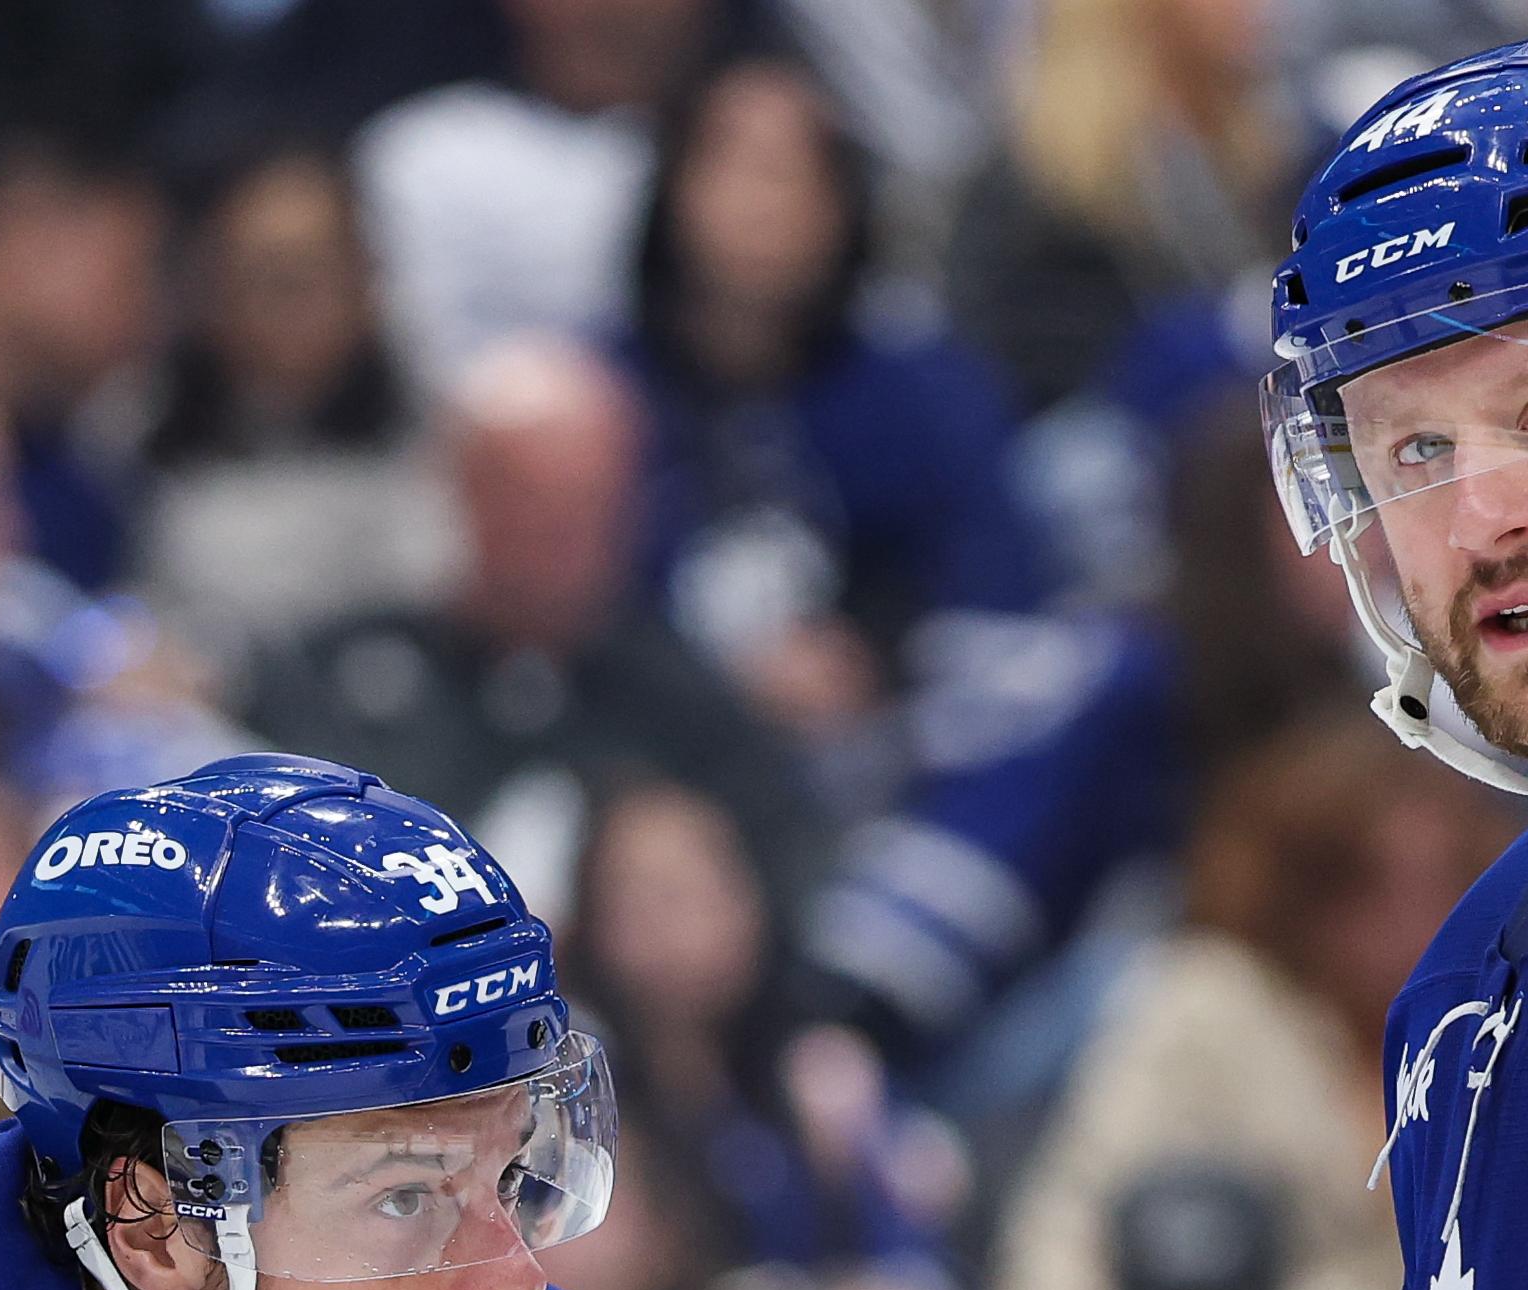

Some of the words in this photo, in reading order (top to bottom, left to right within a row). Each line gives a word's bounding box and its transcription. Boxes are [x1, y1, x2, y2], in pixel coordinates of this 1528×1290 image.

[1349, 90, 1459, 152] 44
[1335, 221, 1456, 284] CCM
[34, 831, 187, 881] OREO
[383, 844, 498, 915] 34
[434, 959, 539, 1016] CCM
[177, 1203, 224, 1219] CCM
